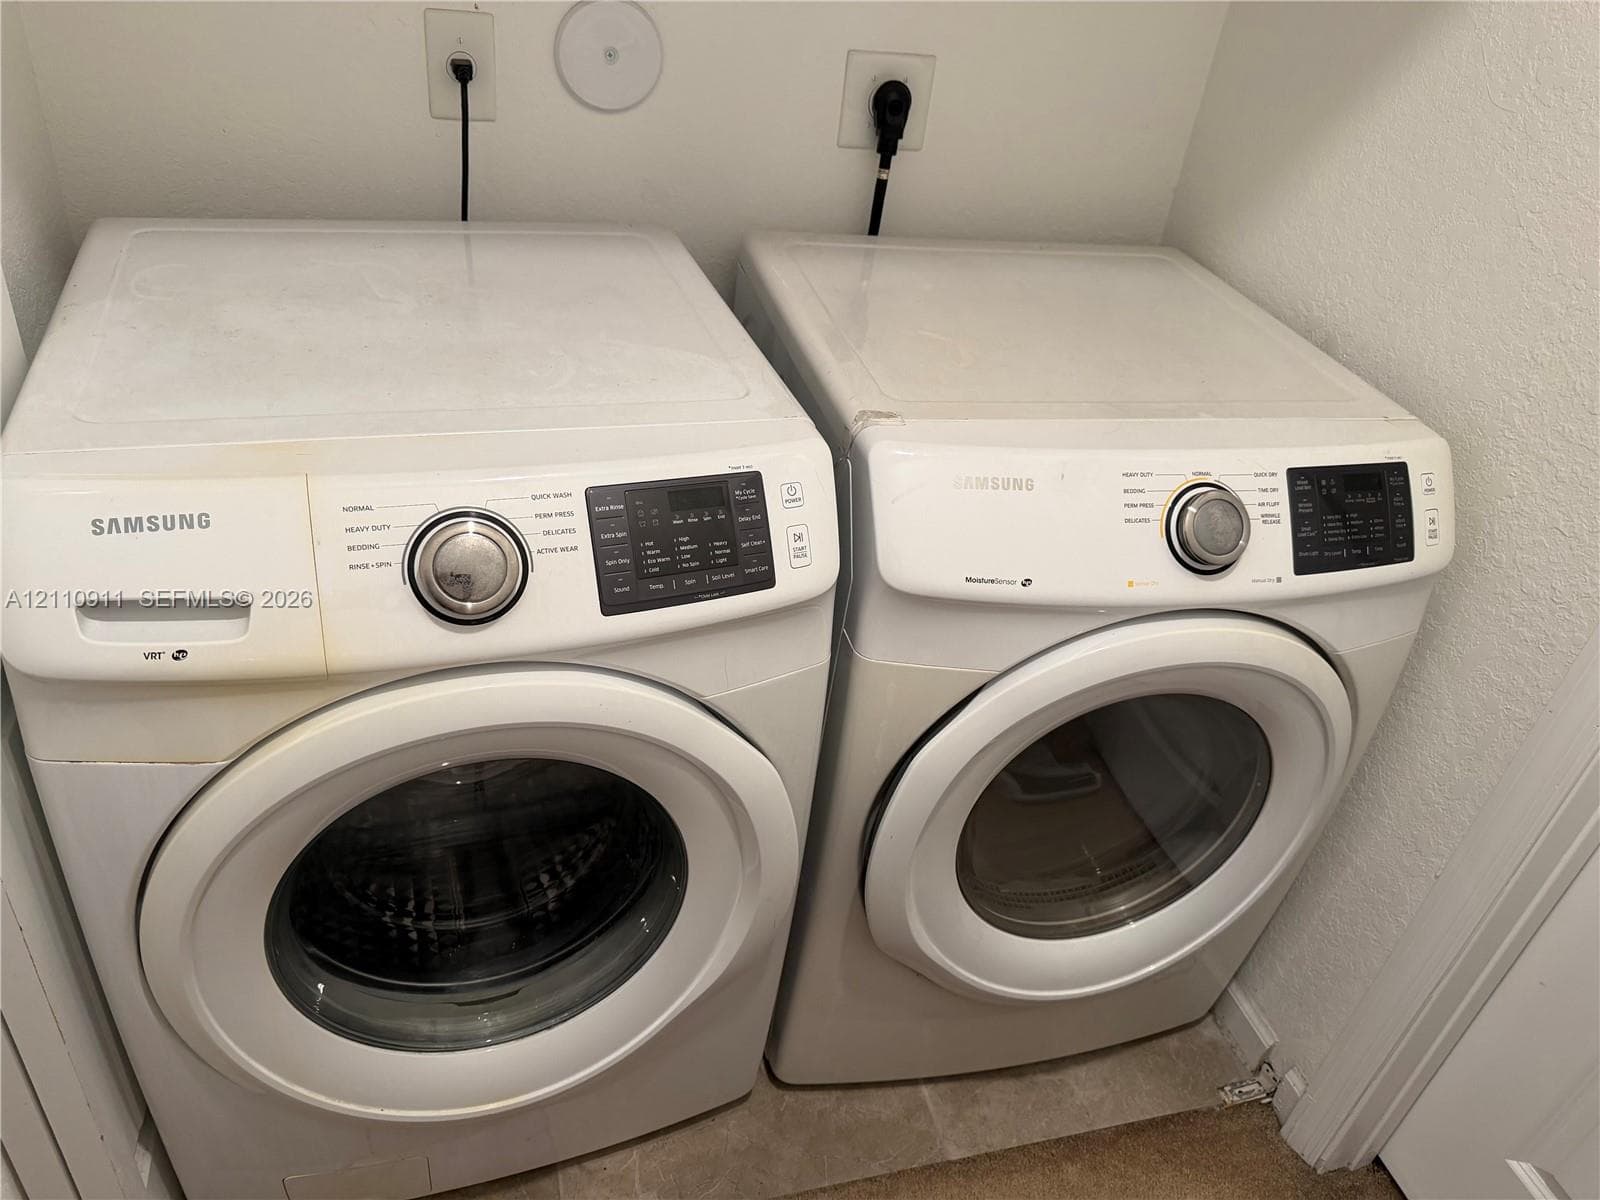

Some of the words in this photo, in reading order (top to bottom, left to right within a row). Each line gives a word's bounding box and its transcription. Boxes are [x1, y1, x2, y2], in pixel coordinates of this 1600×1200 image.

[531, 493, 551, 501] QUICK
[552, 492, 572, 500] WASH
[342, 504, 374, 513] NORMAL
[554, 510, 574, 519] PRESS
[91, 512, 211, 536] SAMSUNG
[345, 525, 369, 534] HEAVY
[371, 524, 391, 532] DUTY
[542, 528, 576, 536] DELICATES
[347, 543, 380, 552] BEDDING
[536, 546, 558, 554] ACTIVE
[560, 546, 578, 554] WEAR
[965, 576, 1017, 585] MoistureSensor
